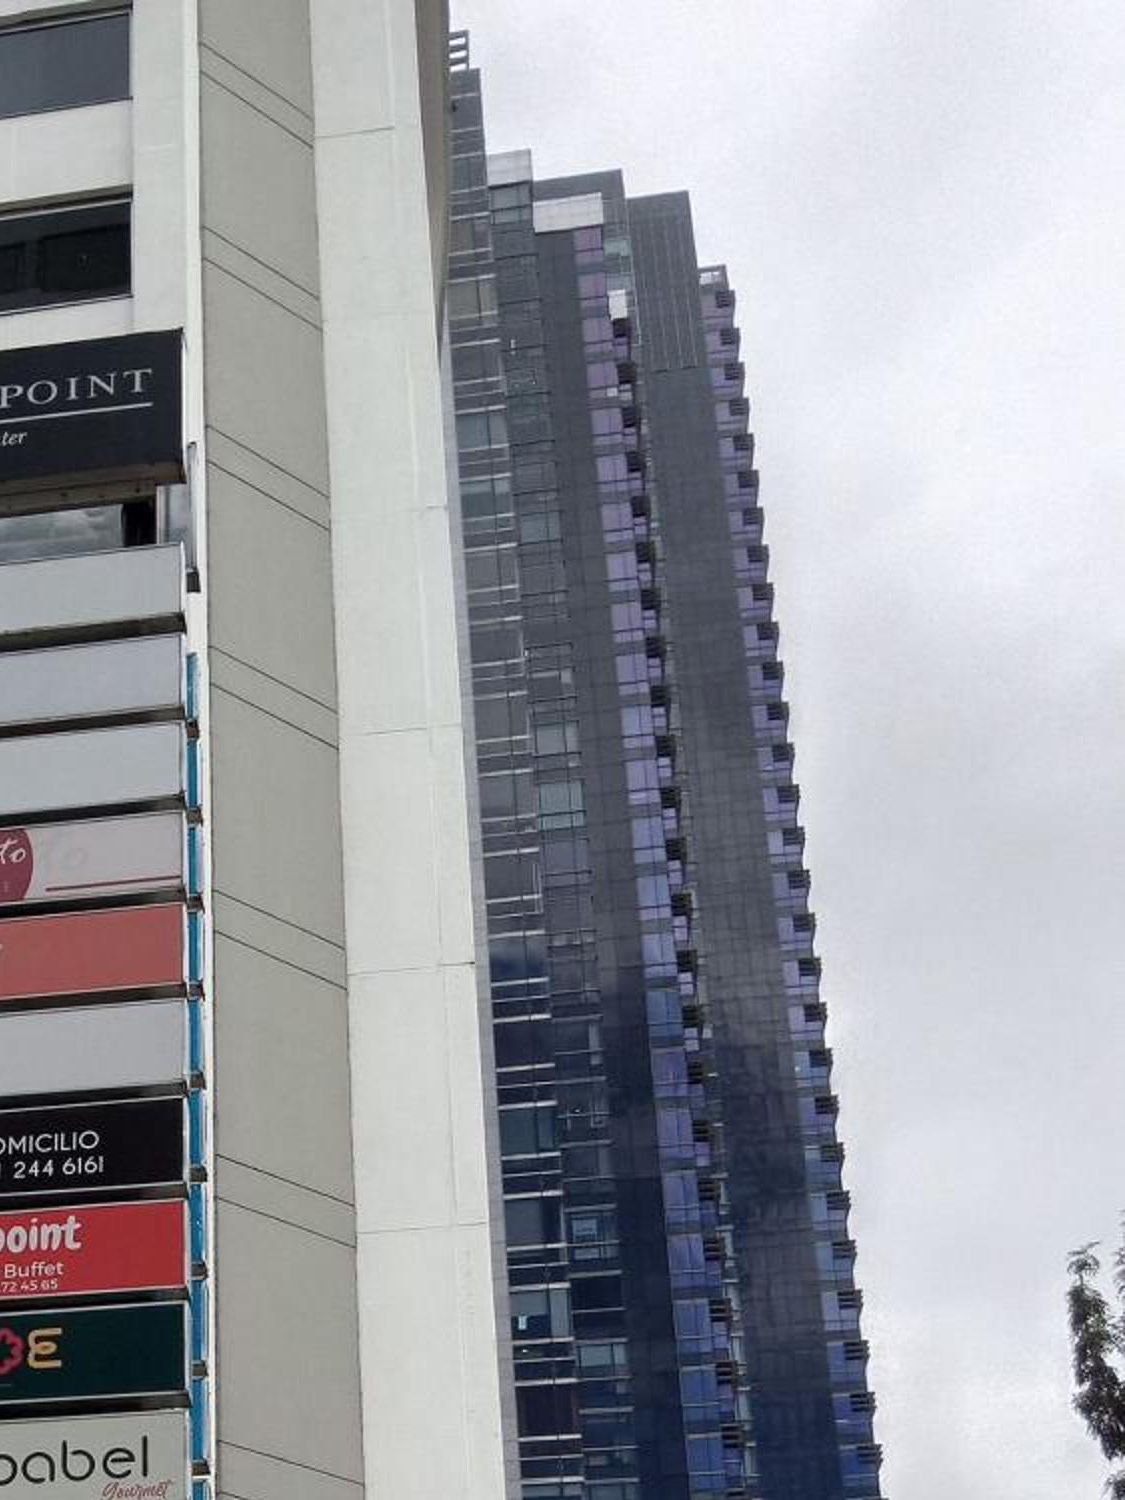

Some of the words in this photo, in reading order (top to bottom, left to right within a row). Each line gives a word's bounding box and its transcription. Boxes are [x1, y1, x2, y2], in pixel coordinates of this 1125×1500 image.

[13, 1159, 54, 1179] 244
[62, 1155, 105, 1175] 6161
[3, 1261, 65, 1279] Buffet
